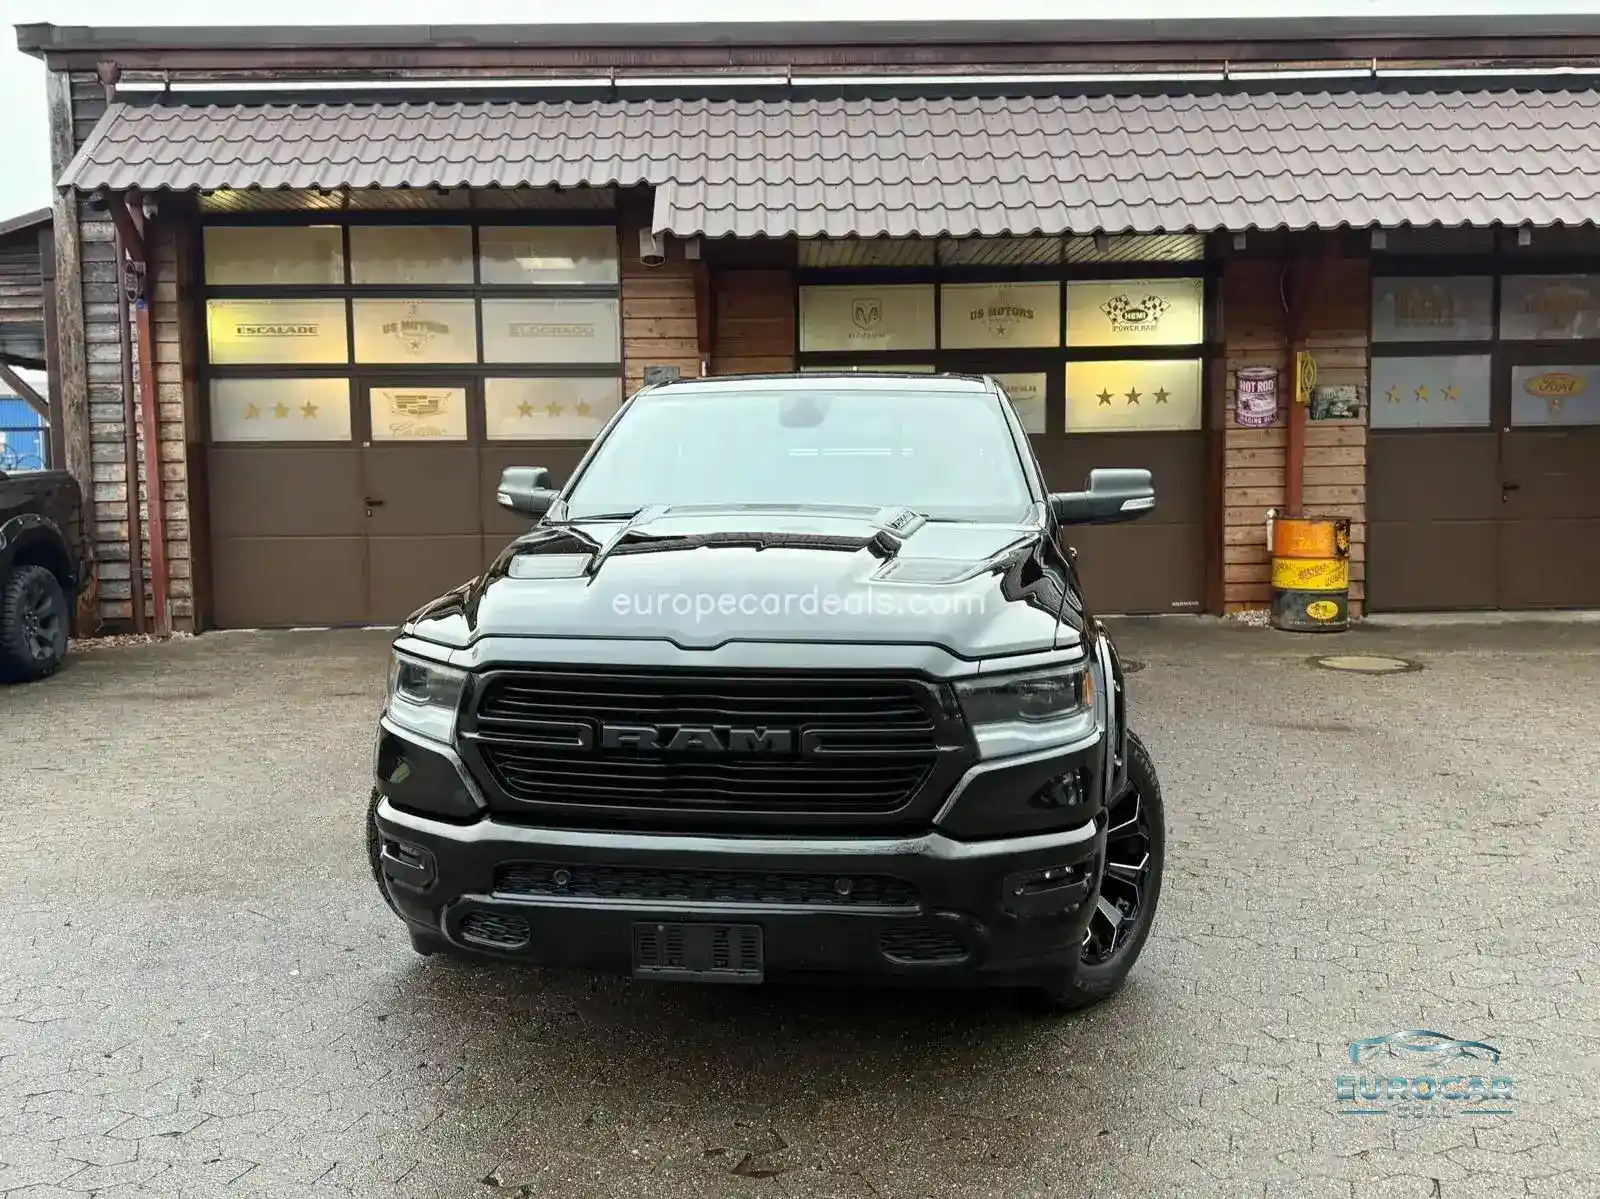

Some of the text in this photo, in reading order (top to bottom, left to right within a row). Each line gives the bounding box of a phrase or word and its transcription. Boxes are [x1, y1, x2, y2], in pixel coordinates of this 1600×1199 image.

[1124, 311, 1147, 320] HEMI
[236, 325, 319, 335] ESCALADE
[1239, 379, 1274, 393] HOT ROD
[601, 723, 792, 753] RAM
